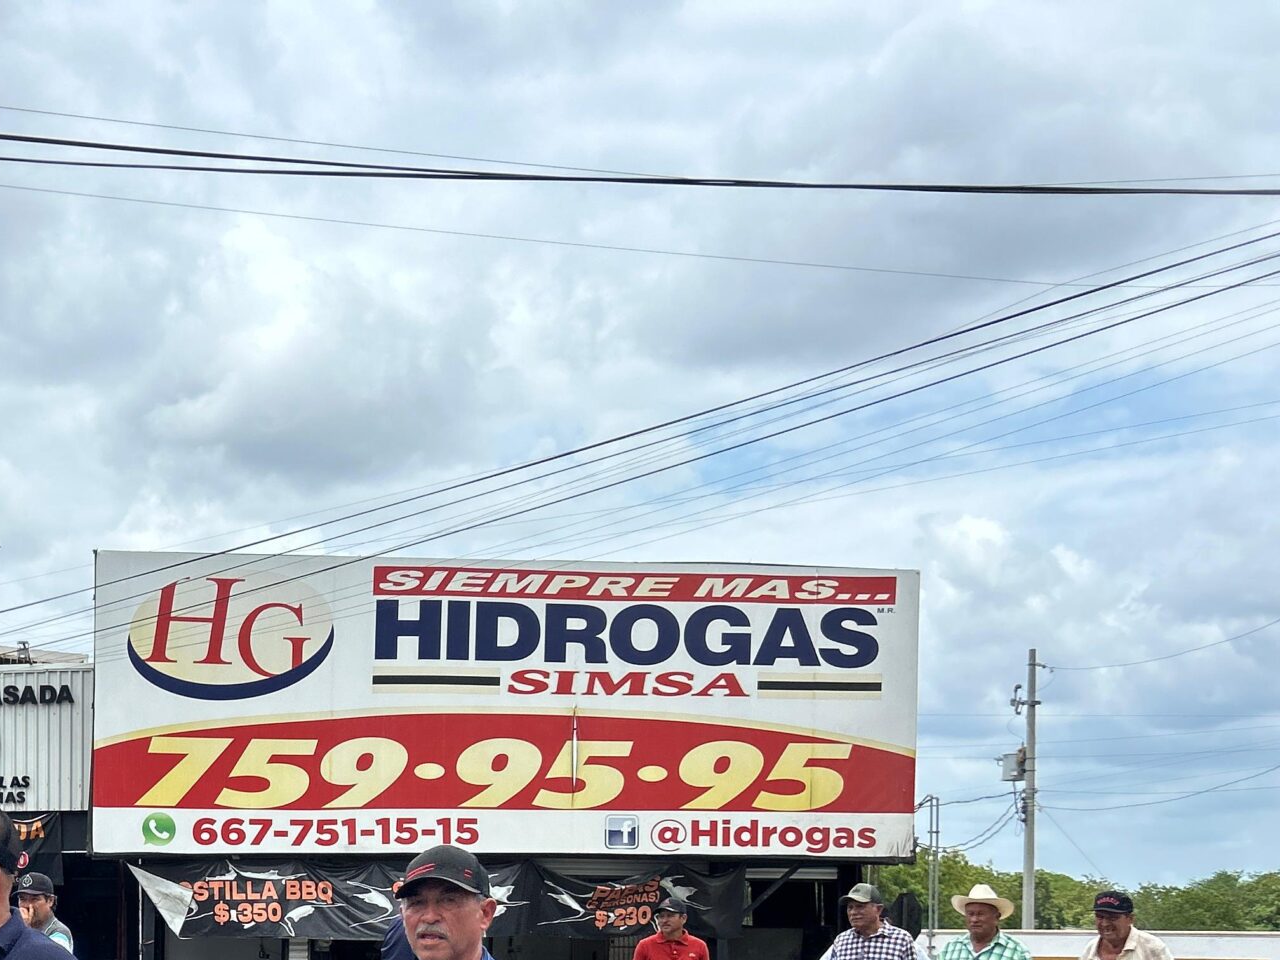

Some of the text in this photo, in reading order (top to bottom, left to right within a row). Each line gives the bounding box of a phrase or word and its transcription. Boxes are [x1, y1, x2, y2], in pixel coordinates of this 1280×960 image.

[379, 570, 890, 601] SIEMPRE MAS...
[143, 577, 312, 678] HG
[374, 599, 879, 668] HIDROGAS
[507, 669, 750, 697] SIMSA
[192, 817, 480, 846] 667-751-15-15
[650, 818, 877, 853] @Hidrogas
[178, 880, 334, 903] STILLA BBQ
[236, 902, 283, 923] 350
[613, 905, 652, 928] 230
